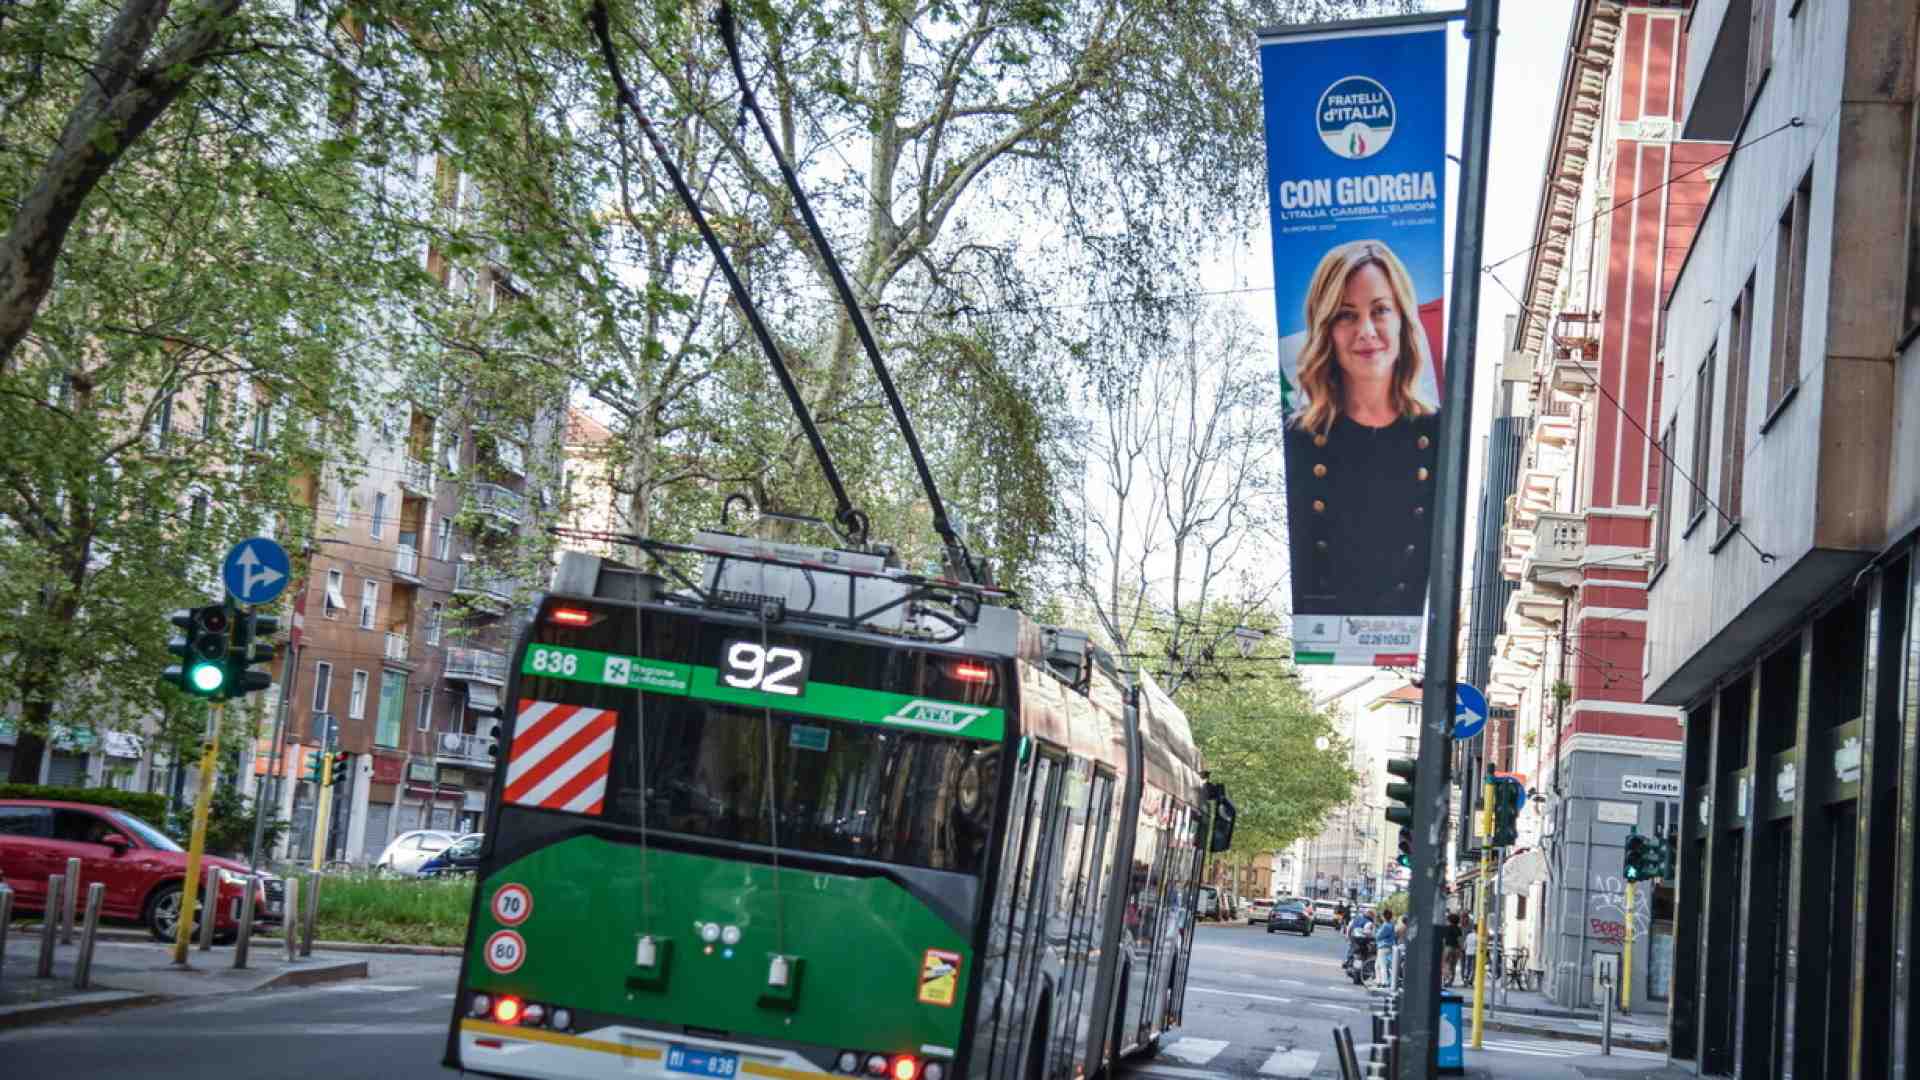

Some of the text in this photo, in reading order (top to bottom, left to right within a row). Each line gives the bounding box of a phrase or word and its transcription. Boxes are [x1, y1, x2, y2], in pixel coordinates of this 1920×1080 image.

[1328, 92, 1383, 107] FRATELLI
[1324, 105, 1389, 122] d'ITALIA
[1280, 171, 1437, 209] CON GIORGIA
[1281, 207, 1327, 220] L'ITALIA
[1330, 205, 1378, 217] CAMBIA
[532, 649, 577, 676] 836
[725, 642, 803, 695] 92
[1624, 779, 1678, 792] Calvairate
[503, 896, 520, 912] 70
[496, 944, 514, 959] 80
